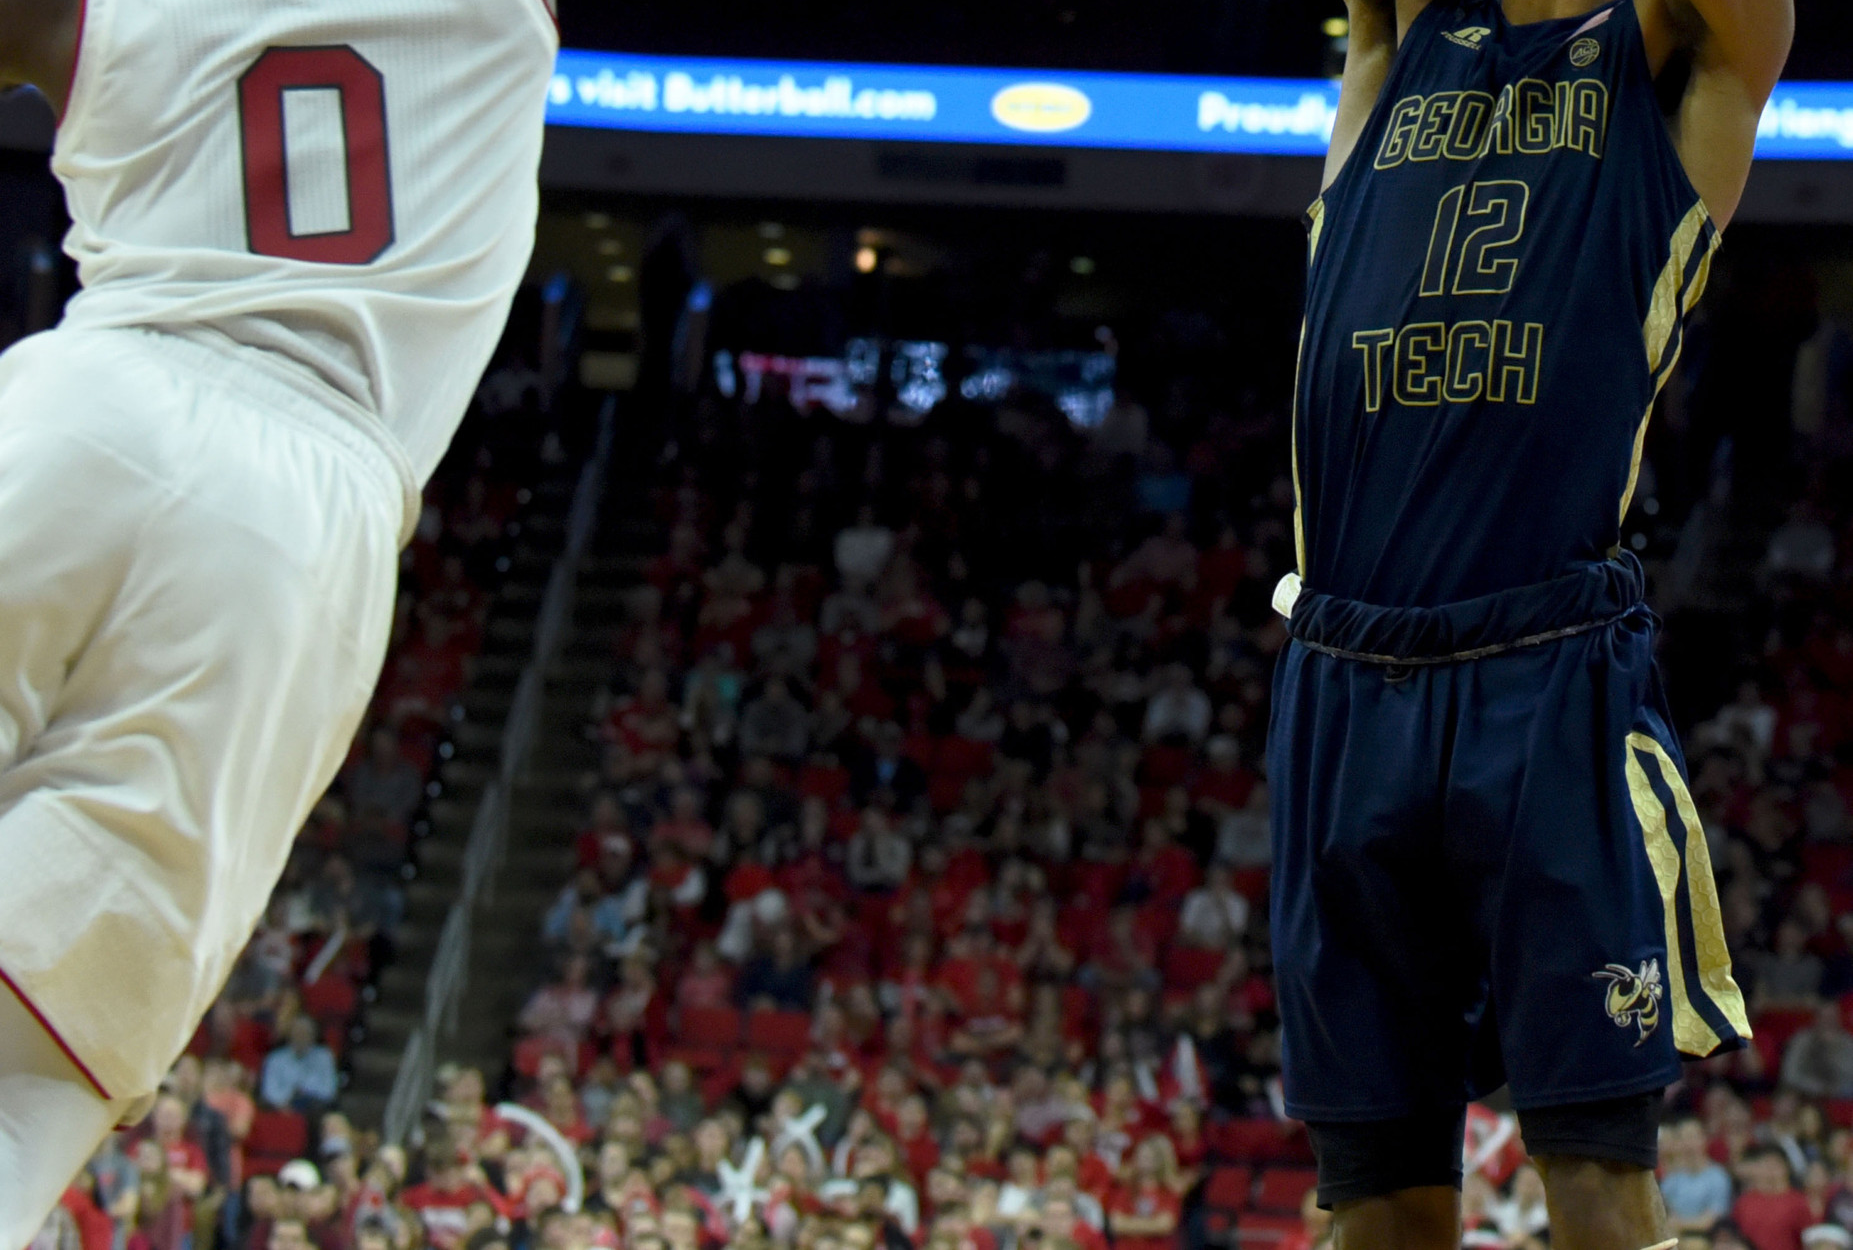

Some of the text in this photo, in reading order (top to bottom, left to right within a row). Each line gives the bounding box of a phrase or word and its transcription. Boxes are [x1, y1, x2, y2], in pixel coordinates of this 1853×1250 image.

[576, 68, 656, 111] visit
[662, 71, 937, 121] Butterball.com
[1373, 77, 1609, 171] GEORGIA
[236, 43, 396, 266] 0
[1418, 179, 1530, 297] 12
[1352, 319, 1544, 413] TECH
